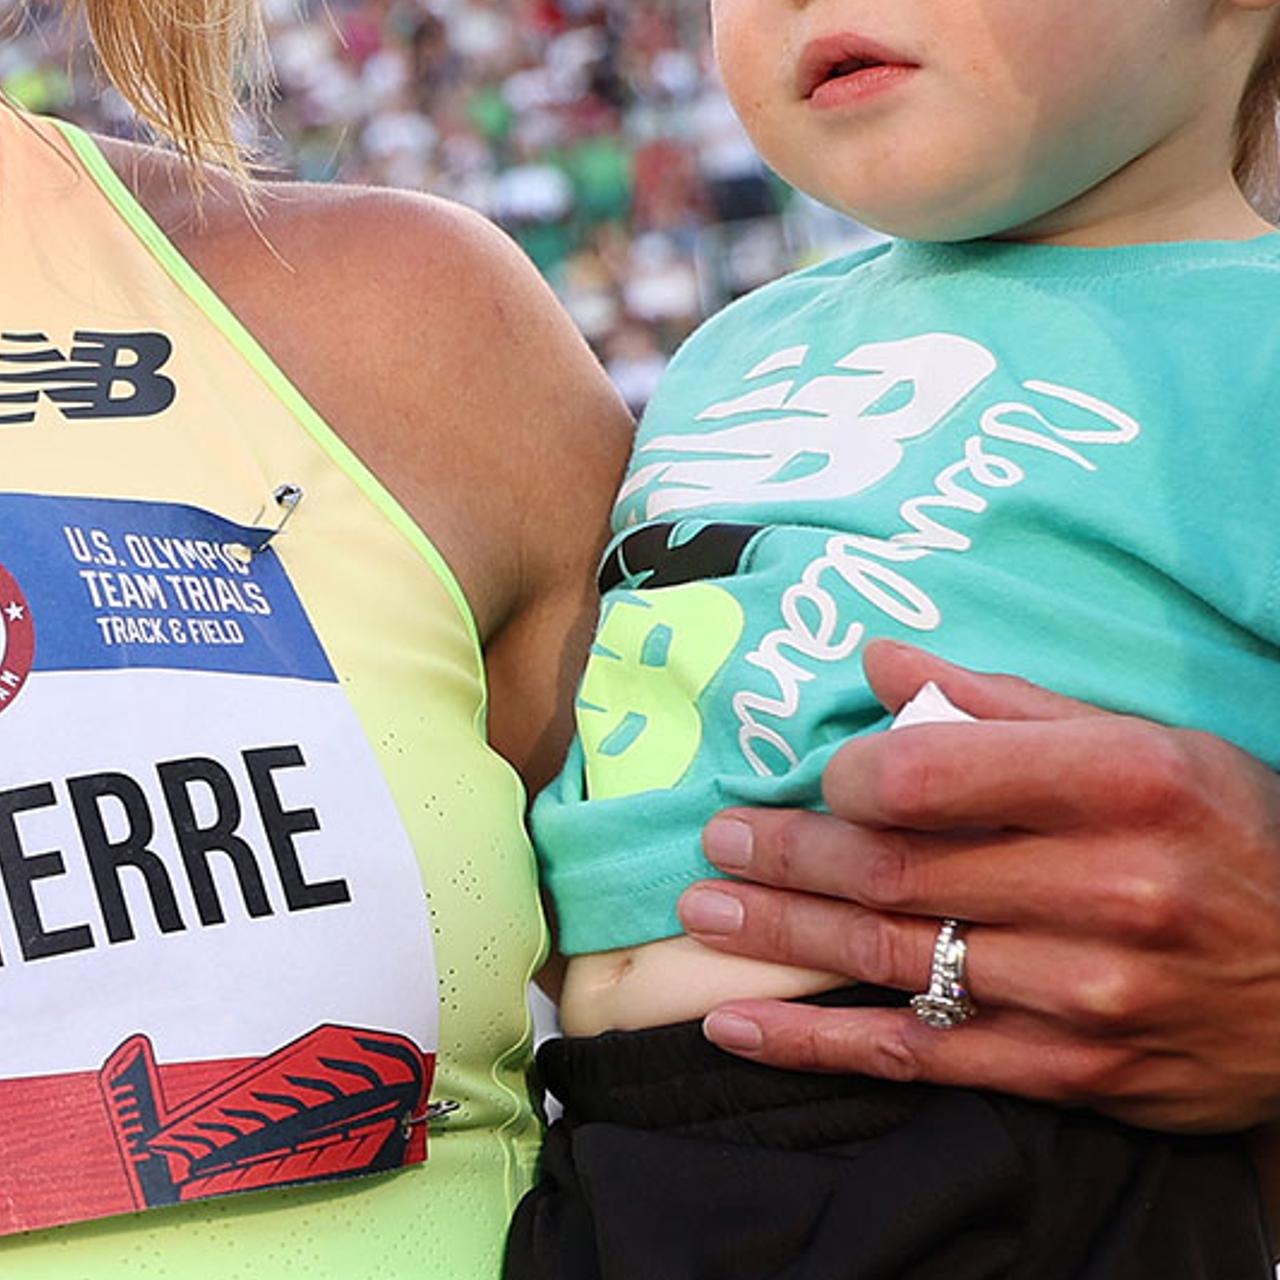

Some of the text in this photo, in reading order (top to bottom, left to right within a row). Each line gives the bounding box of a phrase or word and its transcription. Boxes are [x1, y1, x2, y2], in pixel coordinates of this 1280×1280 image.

[63, 526, 126, 567] U.S.
[79, 569, 272, 615] TEAM TRIALS
[96, 617, 244, 645] TRACK & FIELD
